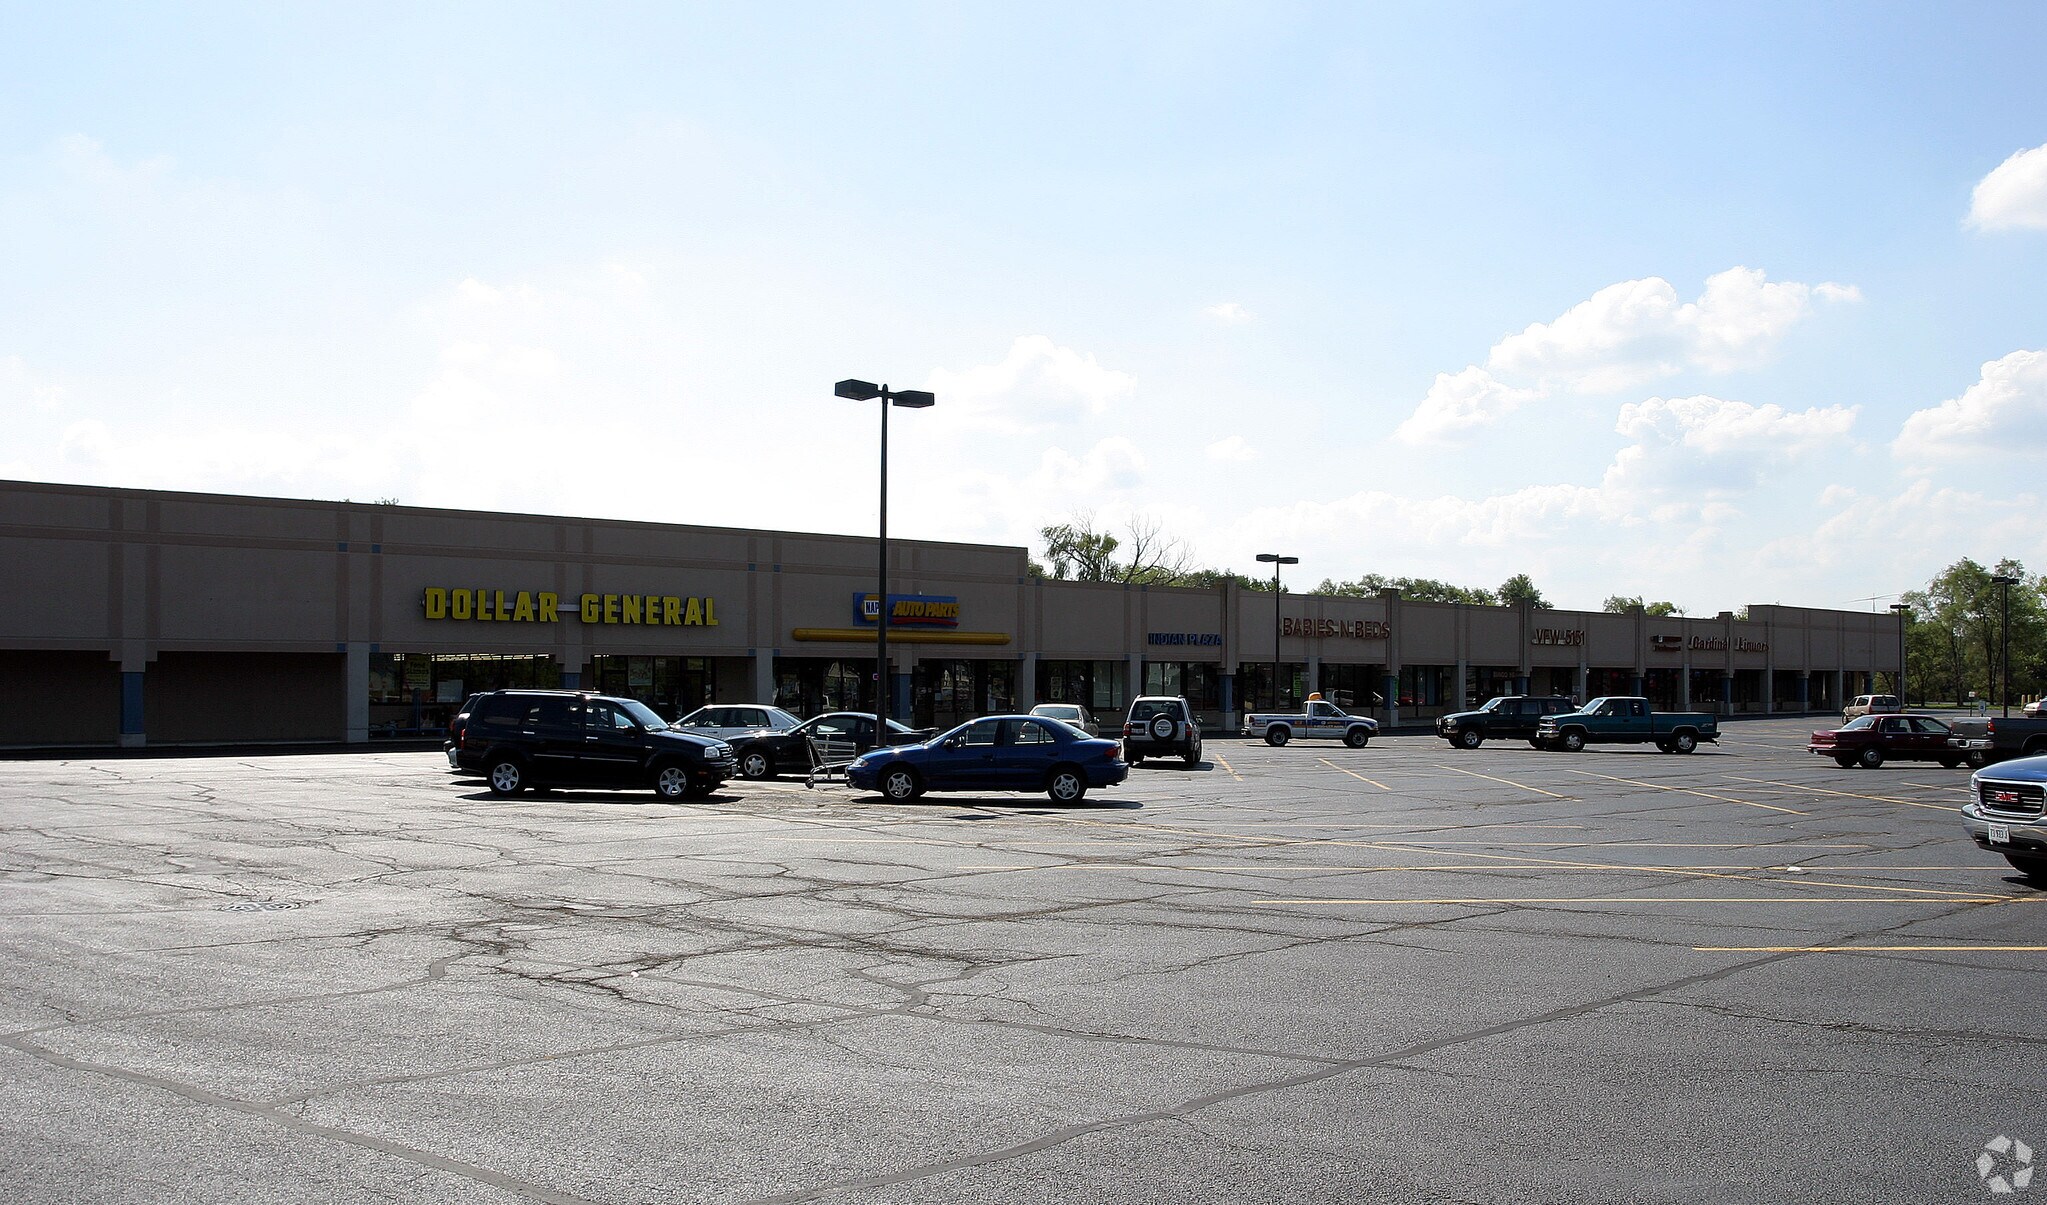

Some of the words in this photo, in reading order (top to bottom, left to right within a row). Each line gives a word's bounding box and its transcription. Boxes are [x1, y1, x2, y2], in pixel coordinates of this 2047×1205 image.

[424, 587, 559, 622] DOLLAR
[580, 592, 719, 626] GENERAL
[865, 601, 880, 614] NAP
[892, 601, 924, 617] AUTO
[924, 602, 960, 618] PARTS
[1282, 617, 1335, 638] BABIES
[1354, 620, 1390, 639] BEDS
[1148, 633, 1185, 645] INDIAN
[1187, 634, 1222, 646] PLAZA
[1536, 628, 1560, 646] VFW
[1565, 630, 1585, 646] 5151
[1690, 635, 1731, 651] Cardinal
[1735, 636, 1769, 653] Liquors
[1995, 790, 2019, 803] GMC
